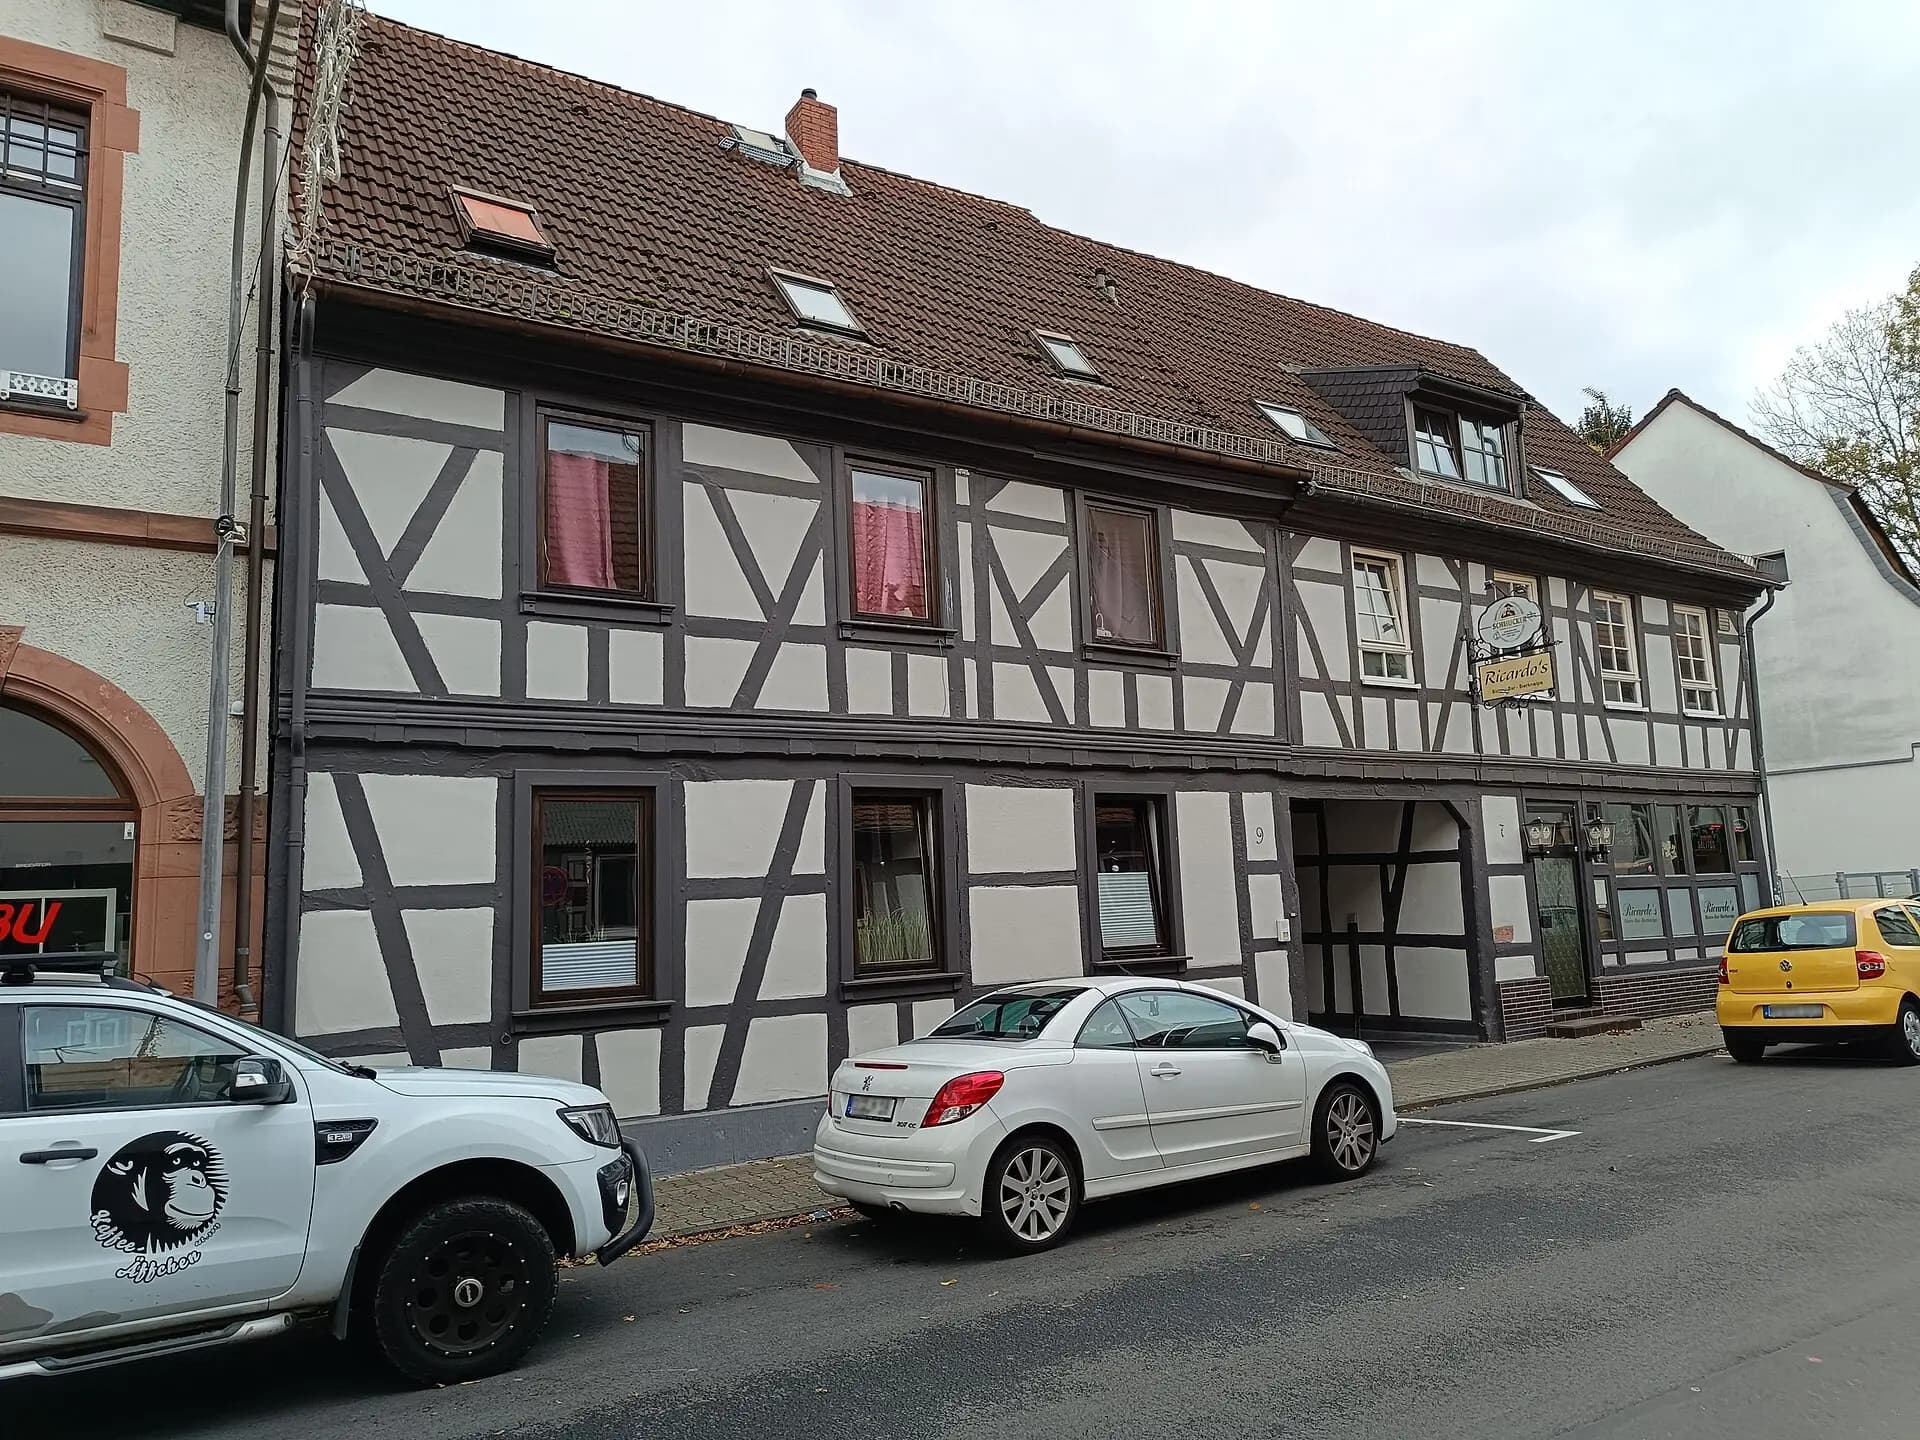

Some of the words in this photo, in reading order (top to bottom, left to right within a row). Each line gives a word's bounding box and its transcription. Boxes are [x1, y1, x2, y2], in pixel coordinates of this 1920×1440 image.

[1485, 660, 1548, 685] Ricardo's
[1255, 827, 1264, 845] 9
[90, 1209, 146, 1254] Kaffee-
[115, 1250, 202, 1284] Äffchen
